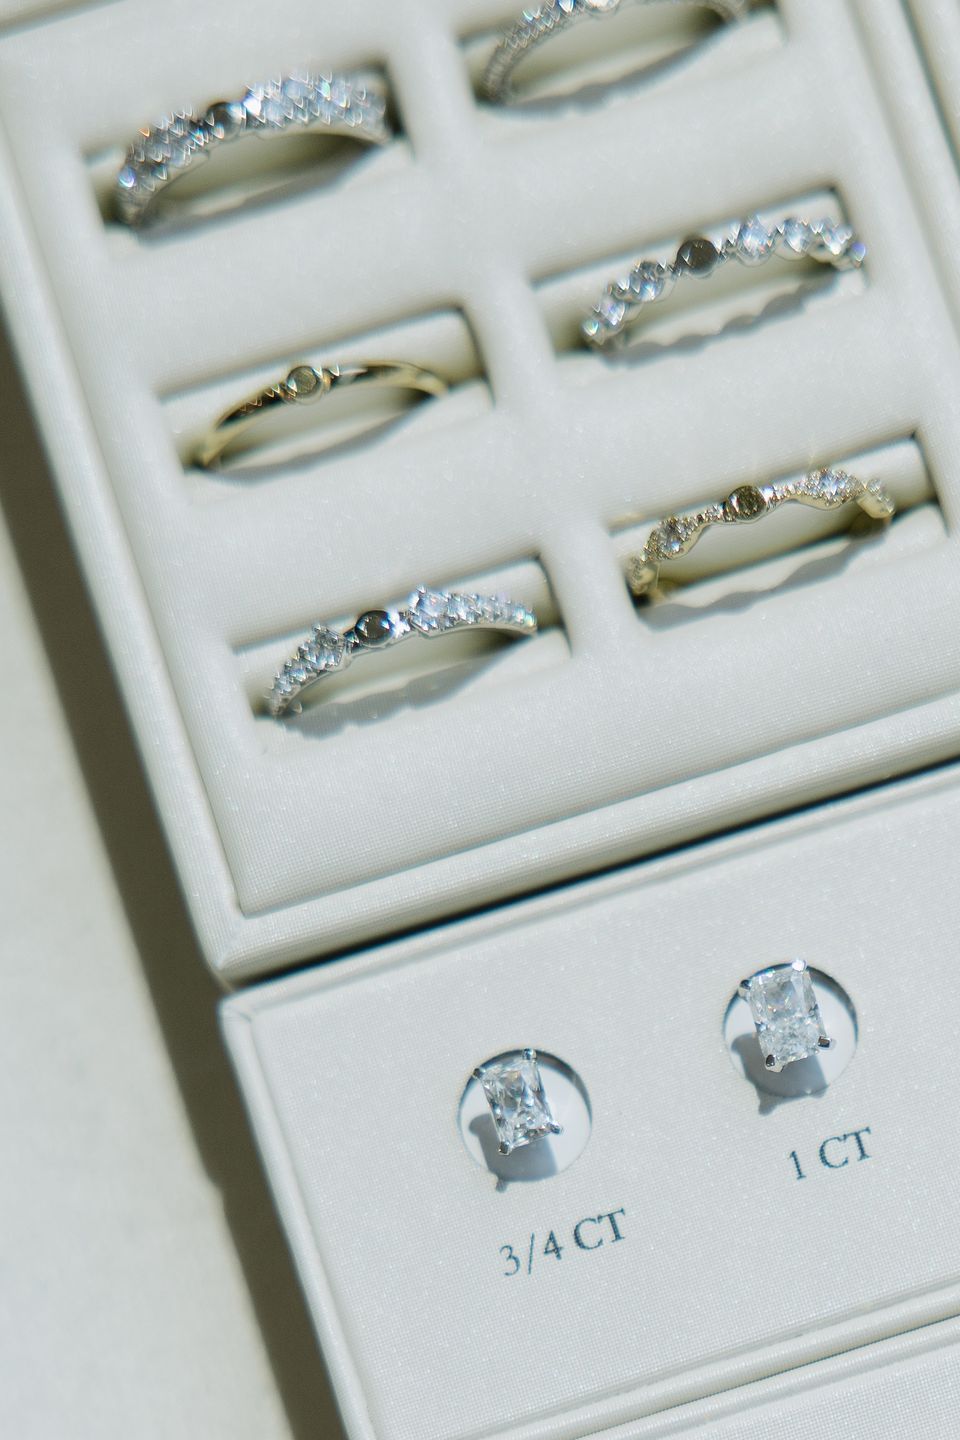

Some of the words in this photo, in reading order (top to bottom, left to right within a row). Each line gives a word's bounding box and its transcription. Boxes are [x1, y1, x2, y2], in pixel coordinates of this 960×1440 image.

[788, 1149, 807, 1181] 1
[818, 1125, 872, 1170] CT
[499, 1229, 565, 1277] 3/4
[572, 1207, 626, 1251] CT
